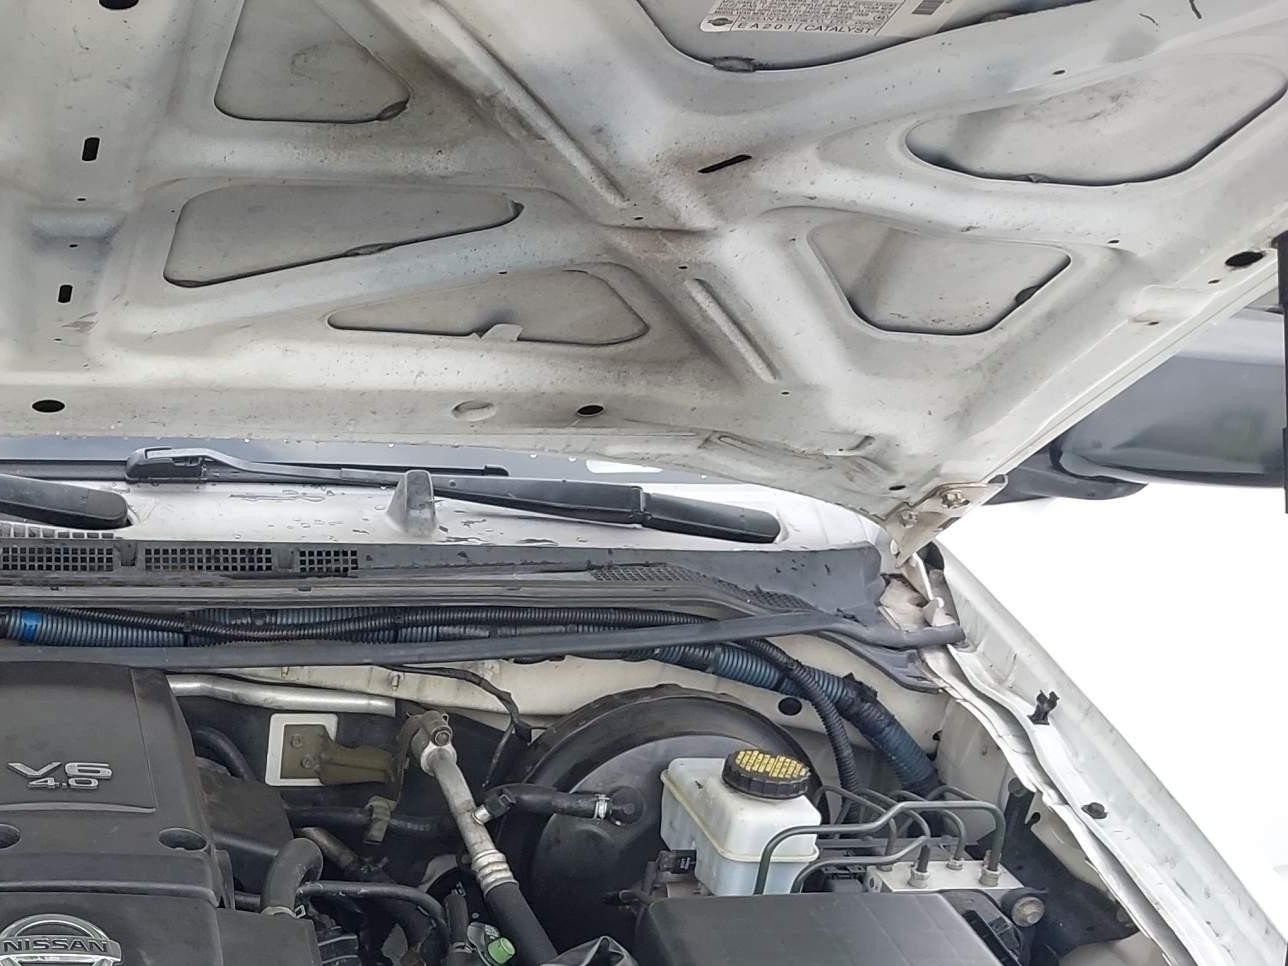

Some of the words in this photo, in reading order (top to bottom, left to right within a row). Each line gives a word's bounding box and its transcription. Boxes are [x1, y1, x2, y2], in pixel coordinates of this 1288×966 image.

[804, 25, 872, 33] CATALYST
[8, 762, 112, 778] V6
[28, 777, 99, 789] 4.0
[3, 939, 107, 952] NISSAN
